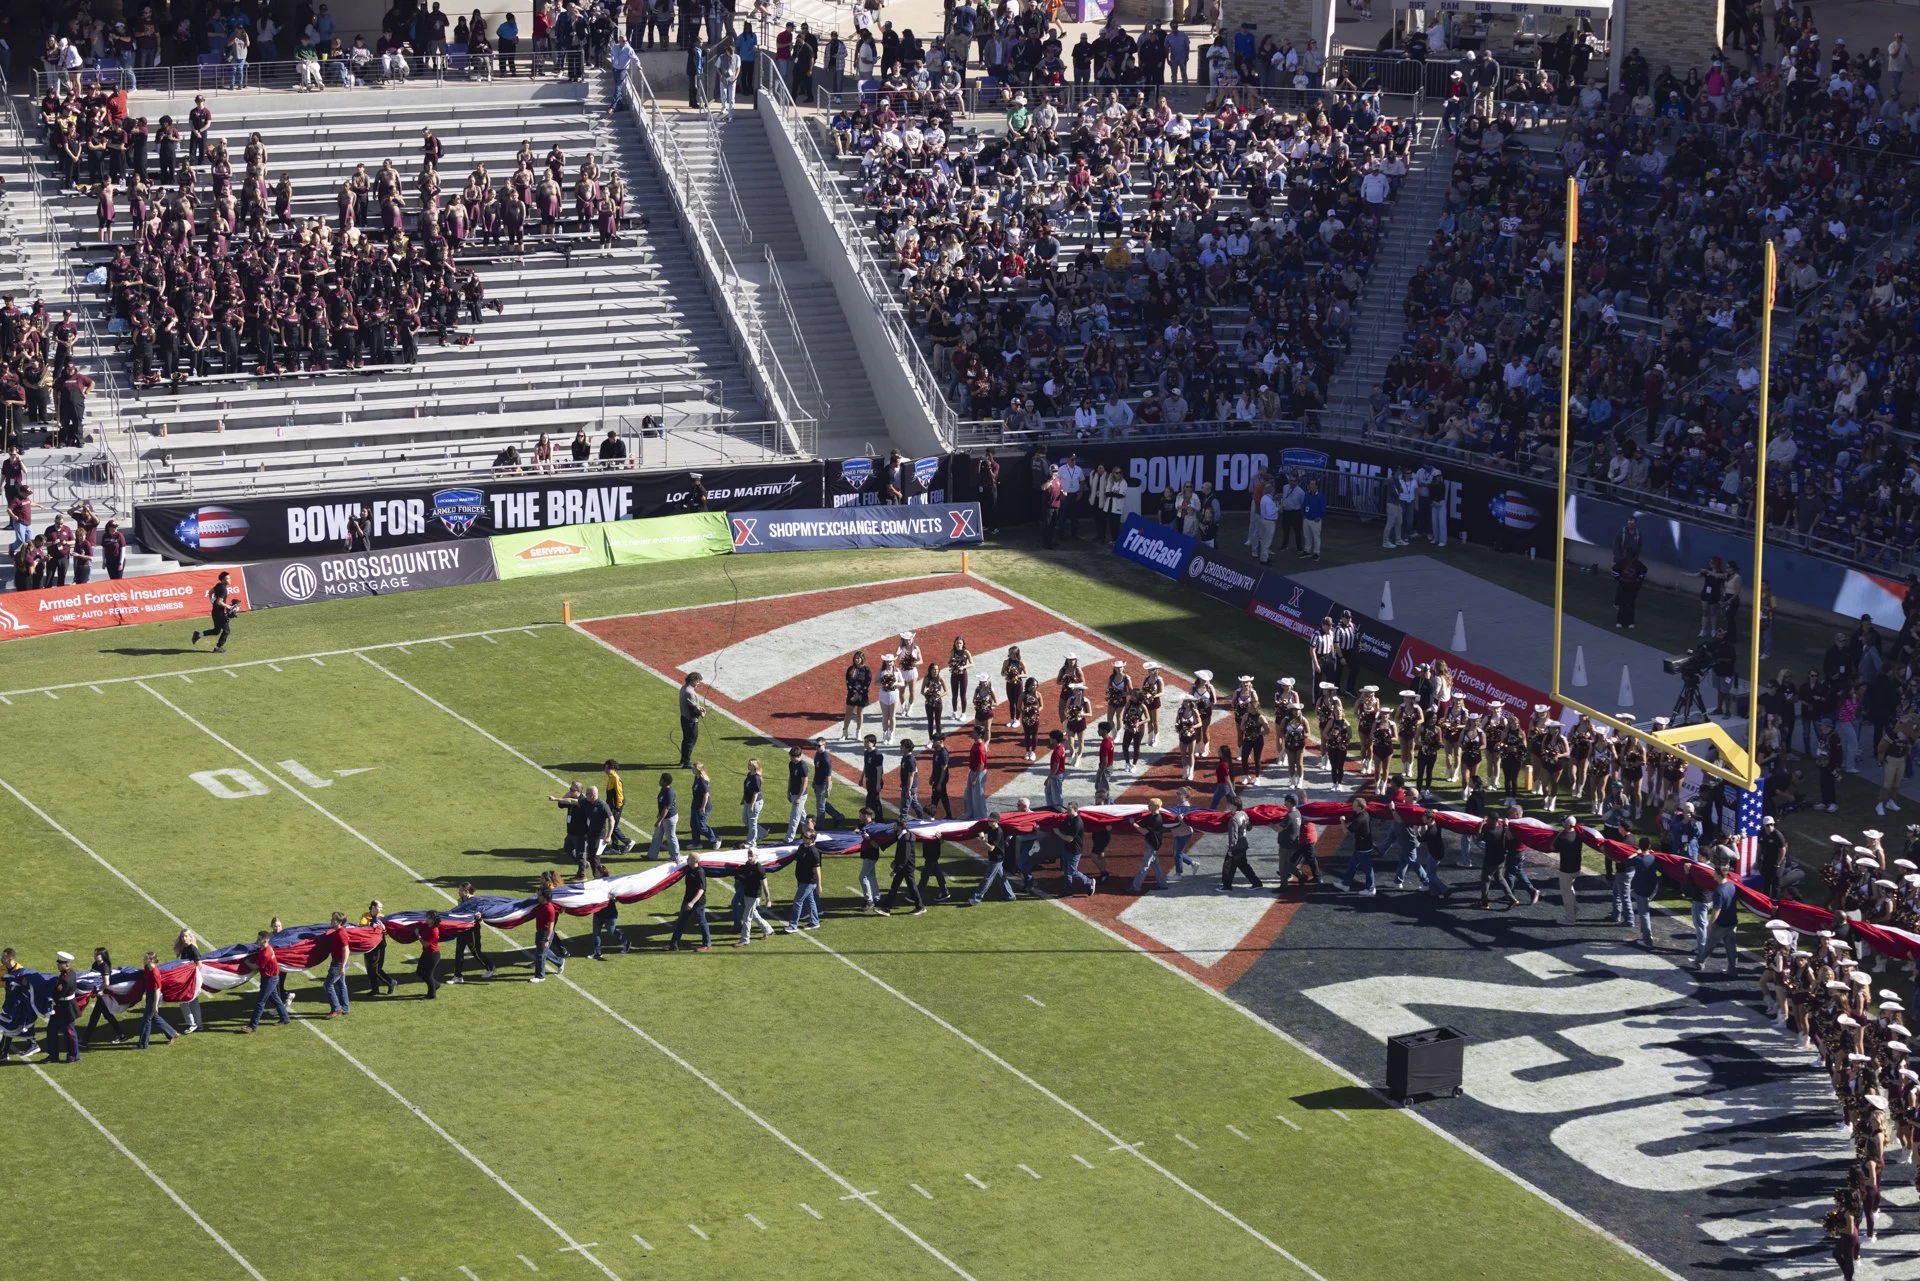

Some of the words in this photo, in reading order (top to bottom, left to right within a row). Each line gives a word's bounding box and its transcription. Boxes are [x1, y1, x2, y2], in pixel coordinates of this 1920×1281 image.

[1408, 1, 1427, 9] RIFF
[1440, 2, 1460, 11] RAM
[1474, 3, 1492, 12] BBQ
[1511, 4, 1529, 13] RIFF
[1543, 6, 1562, 15] RAM
[734, 485, 782, 498] MARTIN
[373, 498, 426, 537] FOR
[490, 491, 545, 529] THE
[547, 485, 633, 527] BRAVE
[432, 506, 457, 517] ARMED
[458, 506, 486, 514] FORCES
[768, 517, 943, 538] SHOPMYEXCHANGE.COM/VETS
[1122, 527, 1183, 569] FirstCash
[321, 547, 460, 582] CROSSCOUNTRY
[1204, 561, 1256, 592] CROSSCOUNTRY
[324, 576, 410, 595] MORTGAGE
[38, 596, 82, 611] Armed
[85, 591, 127, 606] Forces
[130, 585, 193, 601] Insurance
[53, 612, 76, 623] HOME
[81, 610, 103, 619] AUTO
[109, 606, 139, 615] RENTER
[145, 601, 184, 612] BUSINESS
[1457, 670, 1486, 691] Forces
[1486, 682, 1528, 710] Insurance
